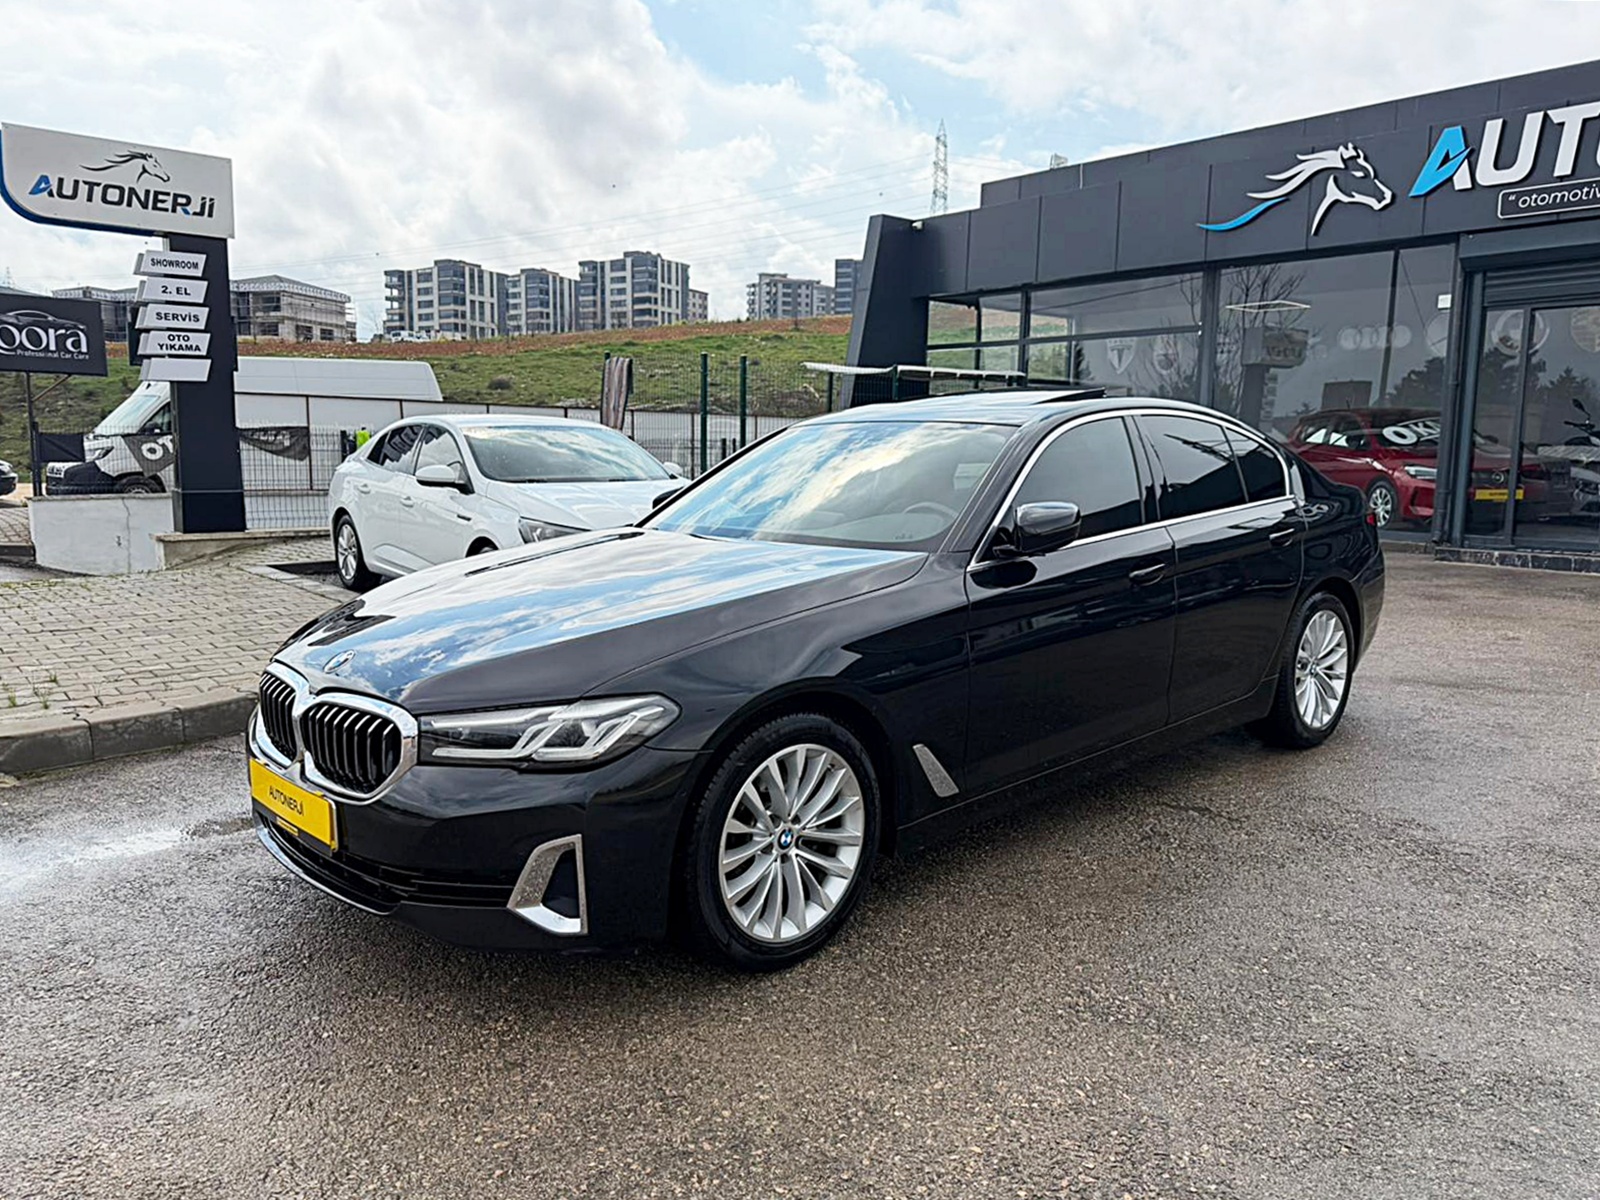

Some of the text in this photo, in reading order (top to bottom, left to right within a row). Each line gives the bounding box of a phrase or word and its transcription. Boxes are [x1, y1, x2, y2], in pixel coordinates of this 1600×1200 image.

[1409, 101, 1600, 197] AUT
[150, 257, 200, 270] SHOWROOM
[161, 285, 191, 296] 2. EL
[155, 311, 200, 323] SERVİS
[167, 333, 190, 342] OTO
[157, 342, 202, 353] YIKAMA
[17, 349, 59, 358] Professinal
